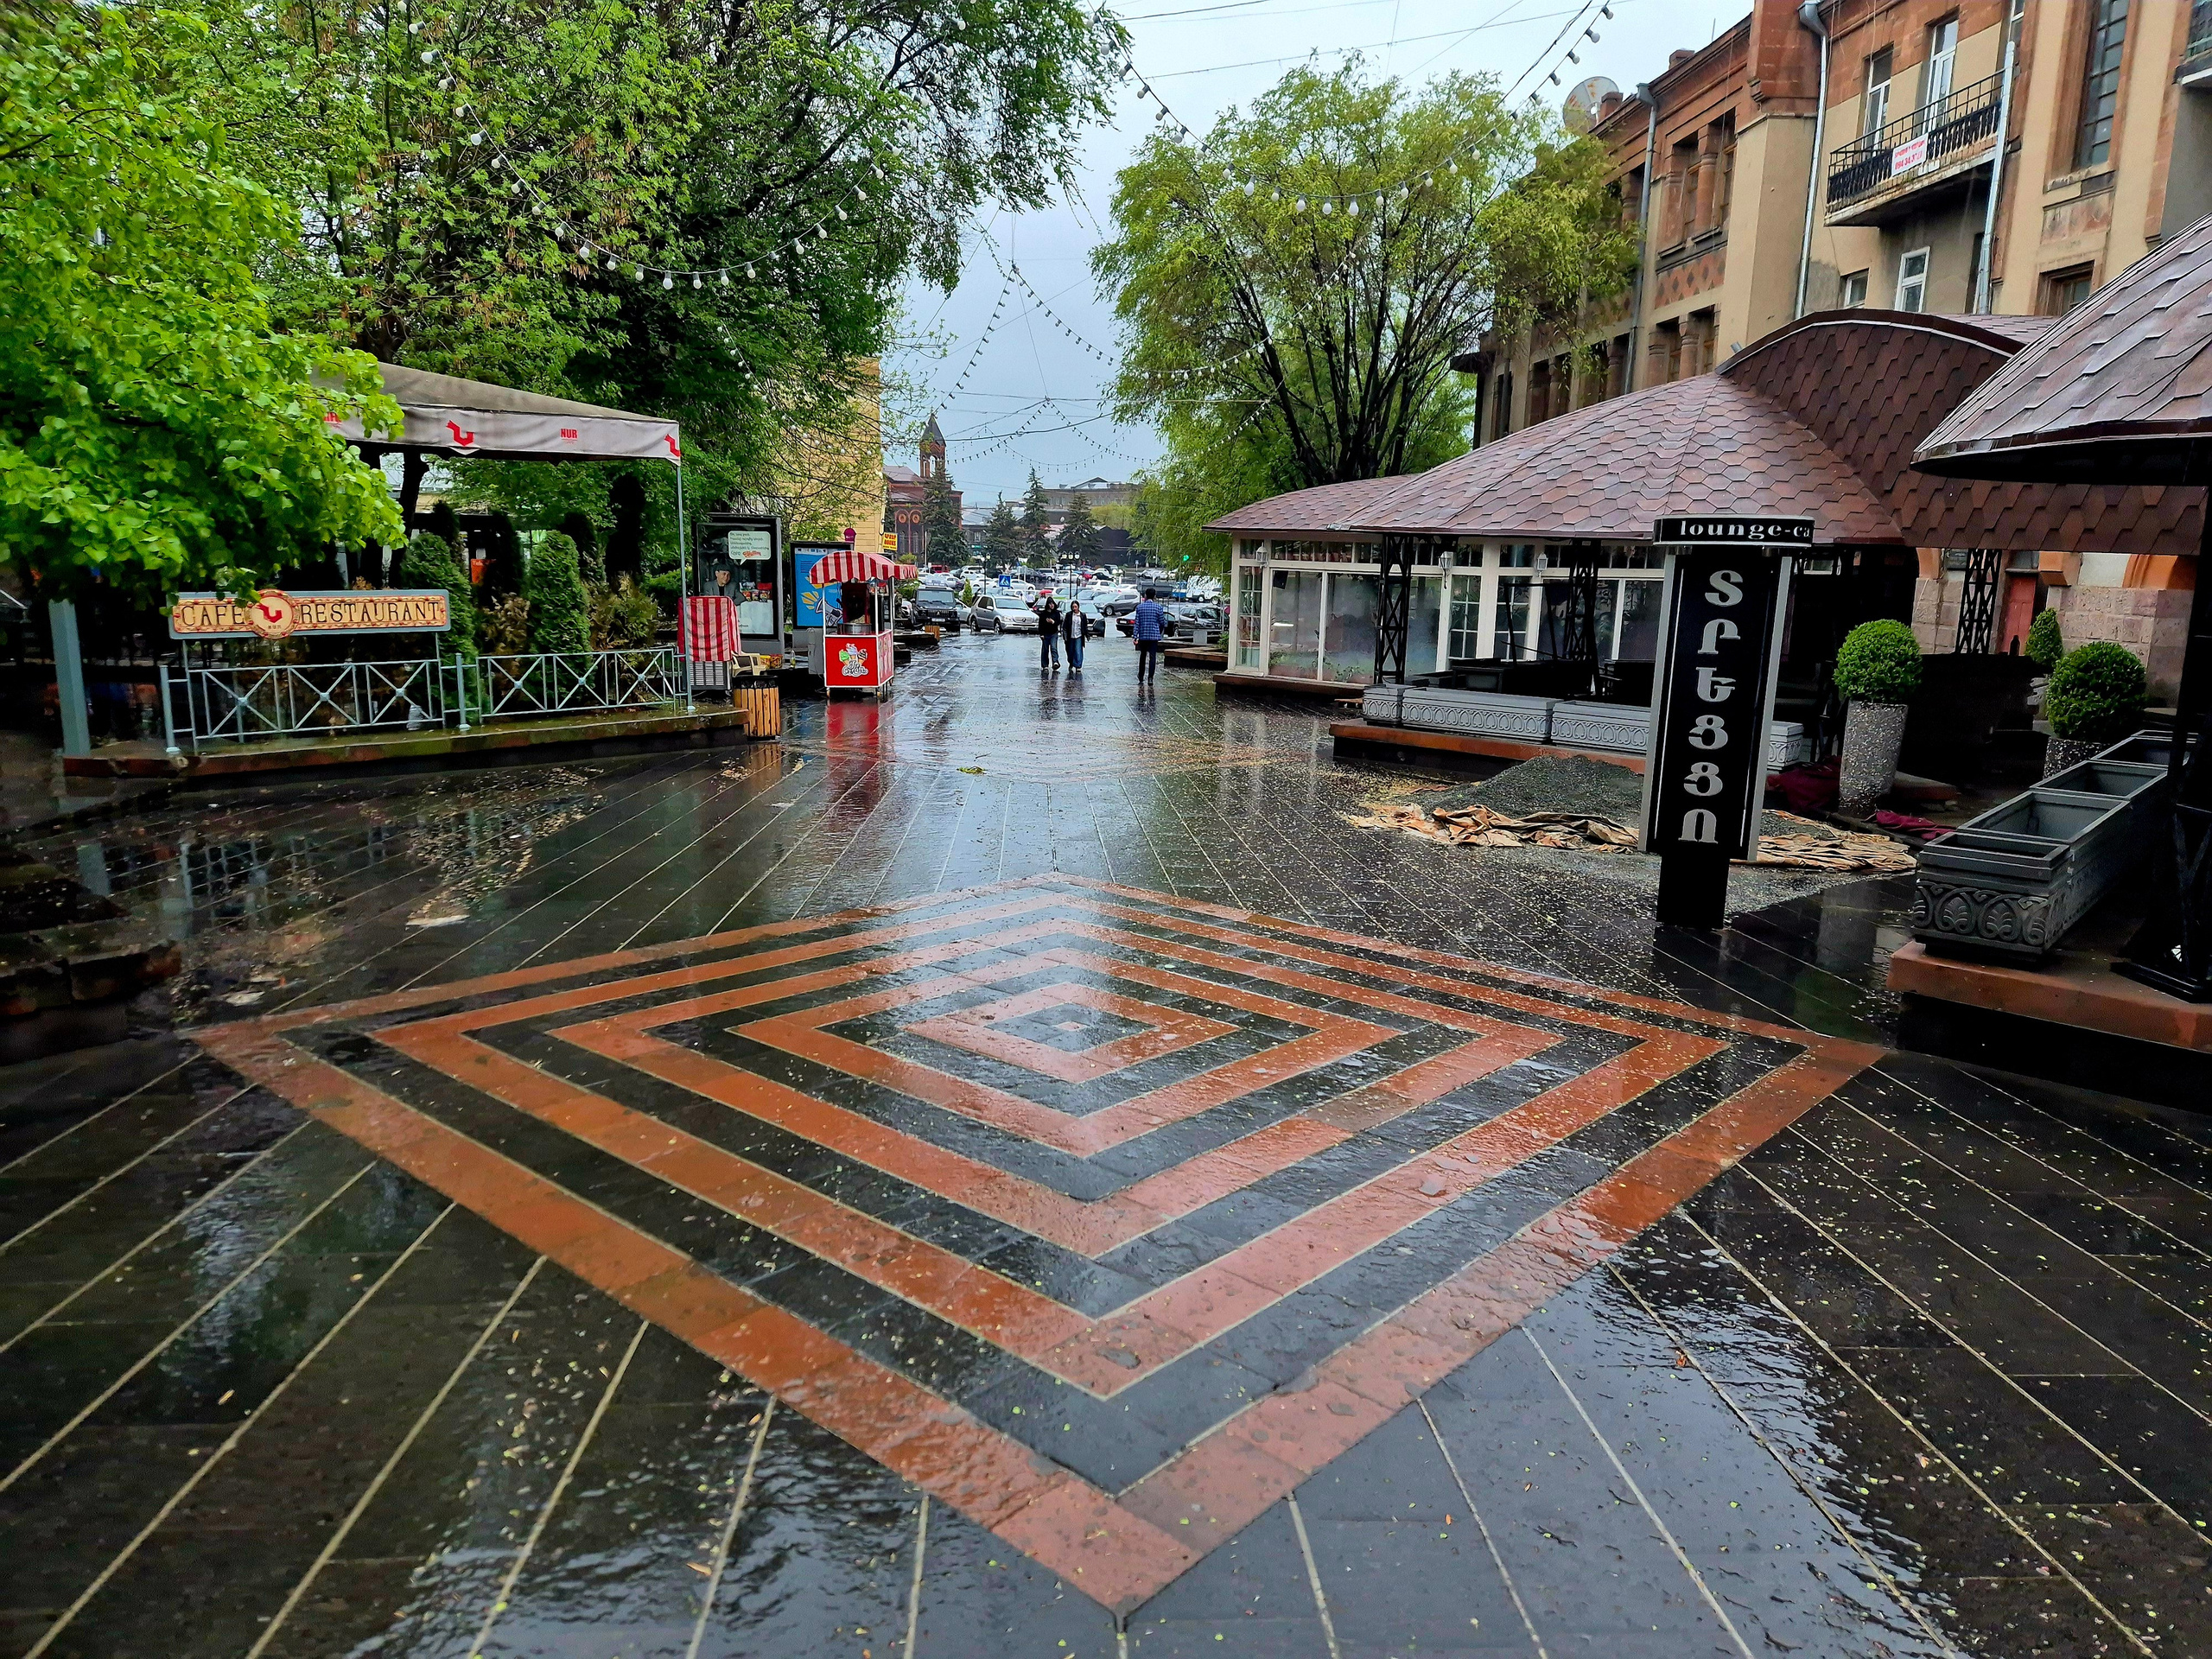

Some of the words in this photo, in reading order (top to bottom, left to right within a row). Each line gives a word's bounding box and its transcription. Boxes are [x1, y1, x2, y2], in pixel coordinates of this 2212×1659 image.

[560, 428, 578, 439] NUR
[181, 605, 247, 626] CAFE
[300, 601, 441, 624] RESTAURANT
